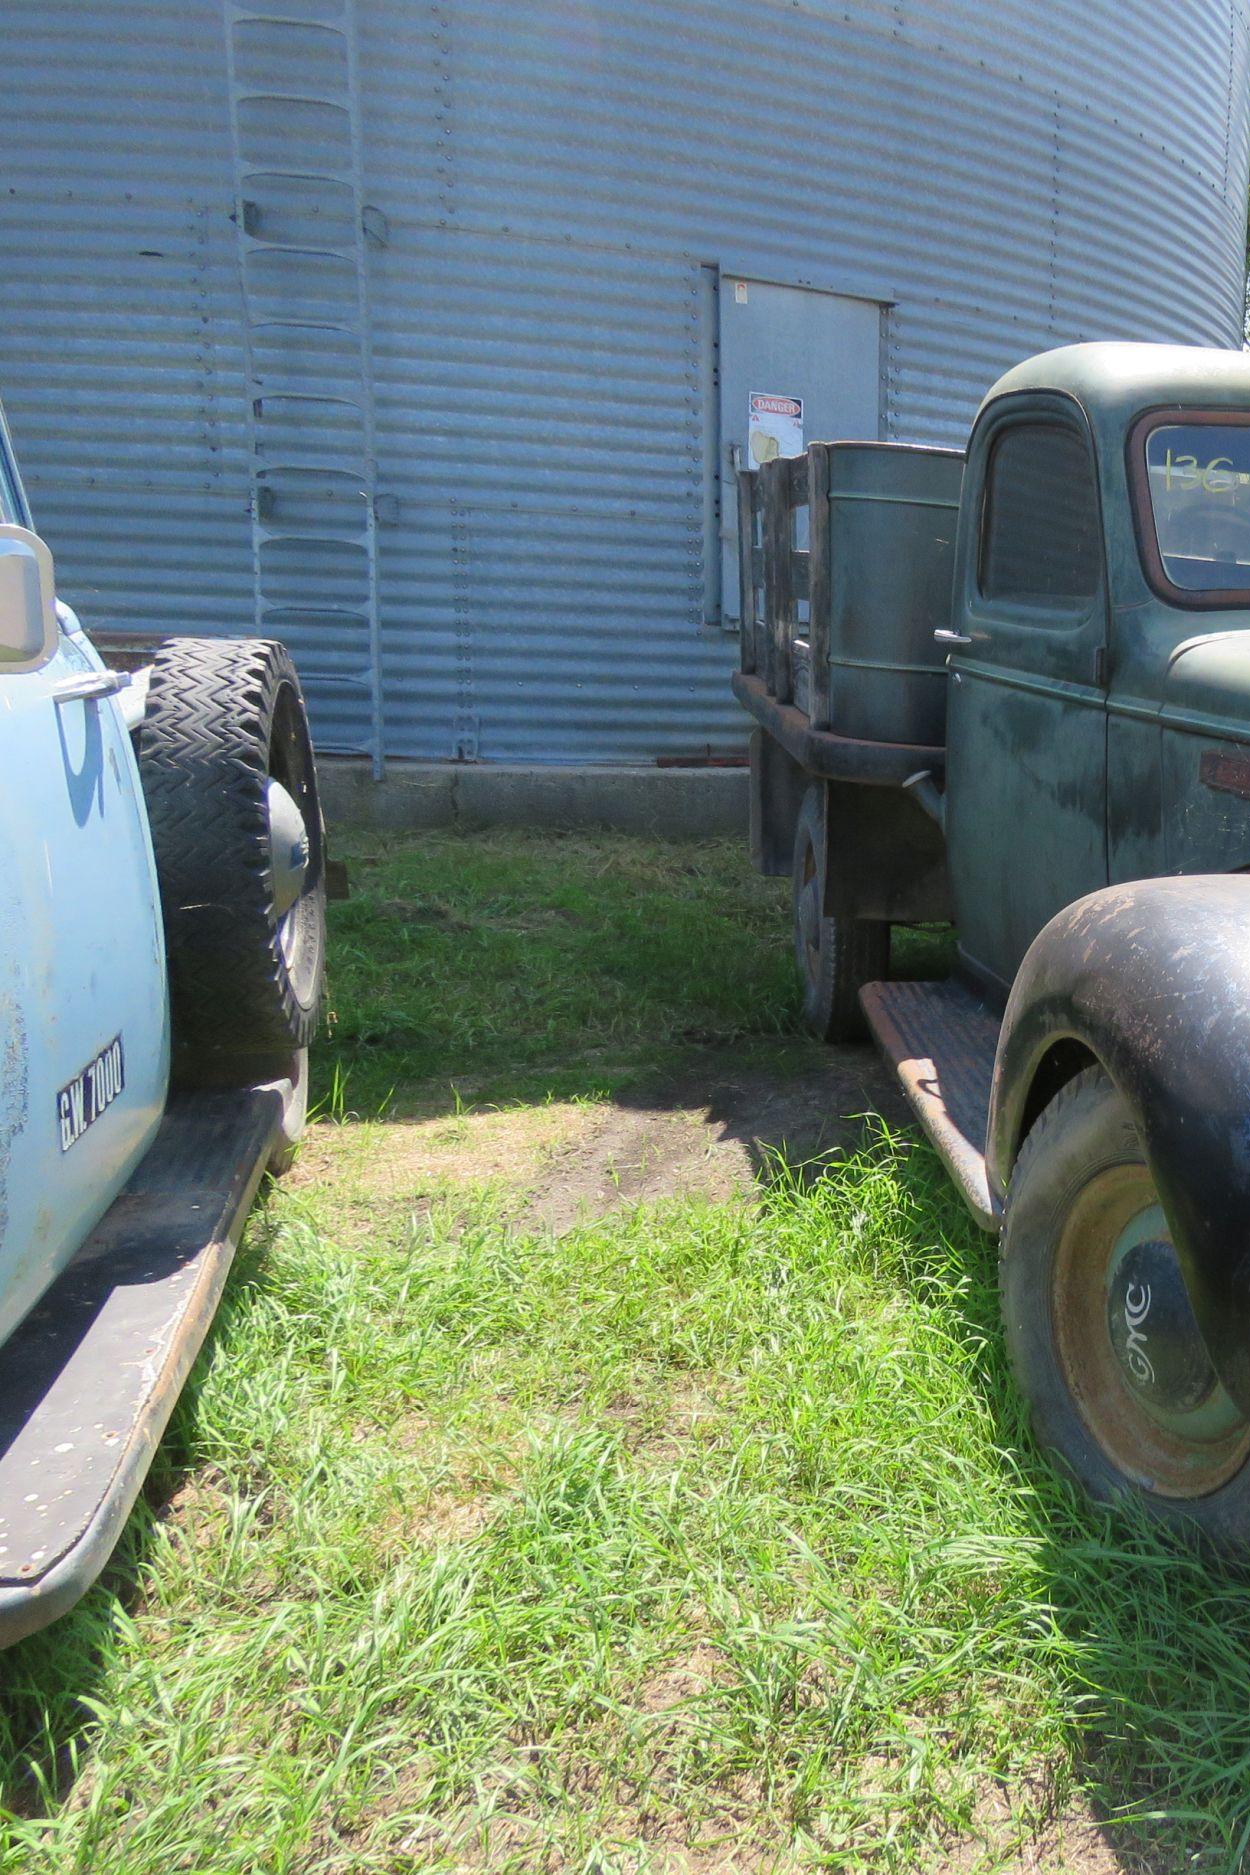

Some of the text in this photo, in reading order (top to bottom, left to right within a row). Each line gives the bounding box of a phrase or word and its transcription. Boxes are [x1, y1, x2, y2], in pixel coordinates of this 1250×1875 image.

[758, 399, 795, 414] DANGER
[88, 1040, 122, 1122] 7000
[1124, 1281, 1155, 1384] GMC
